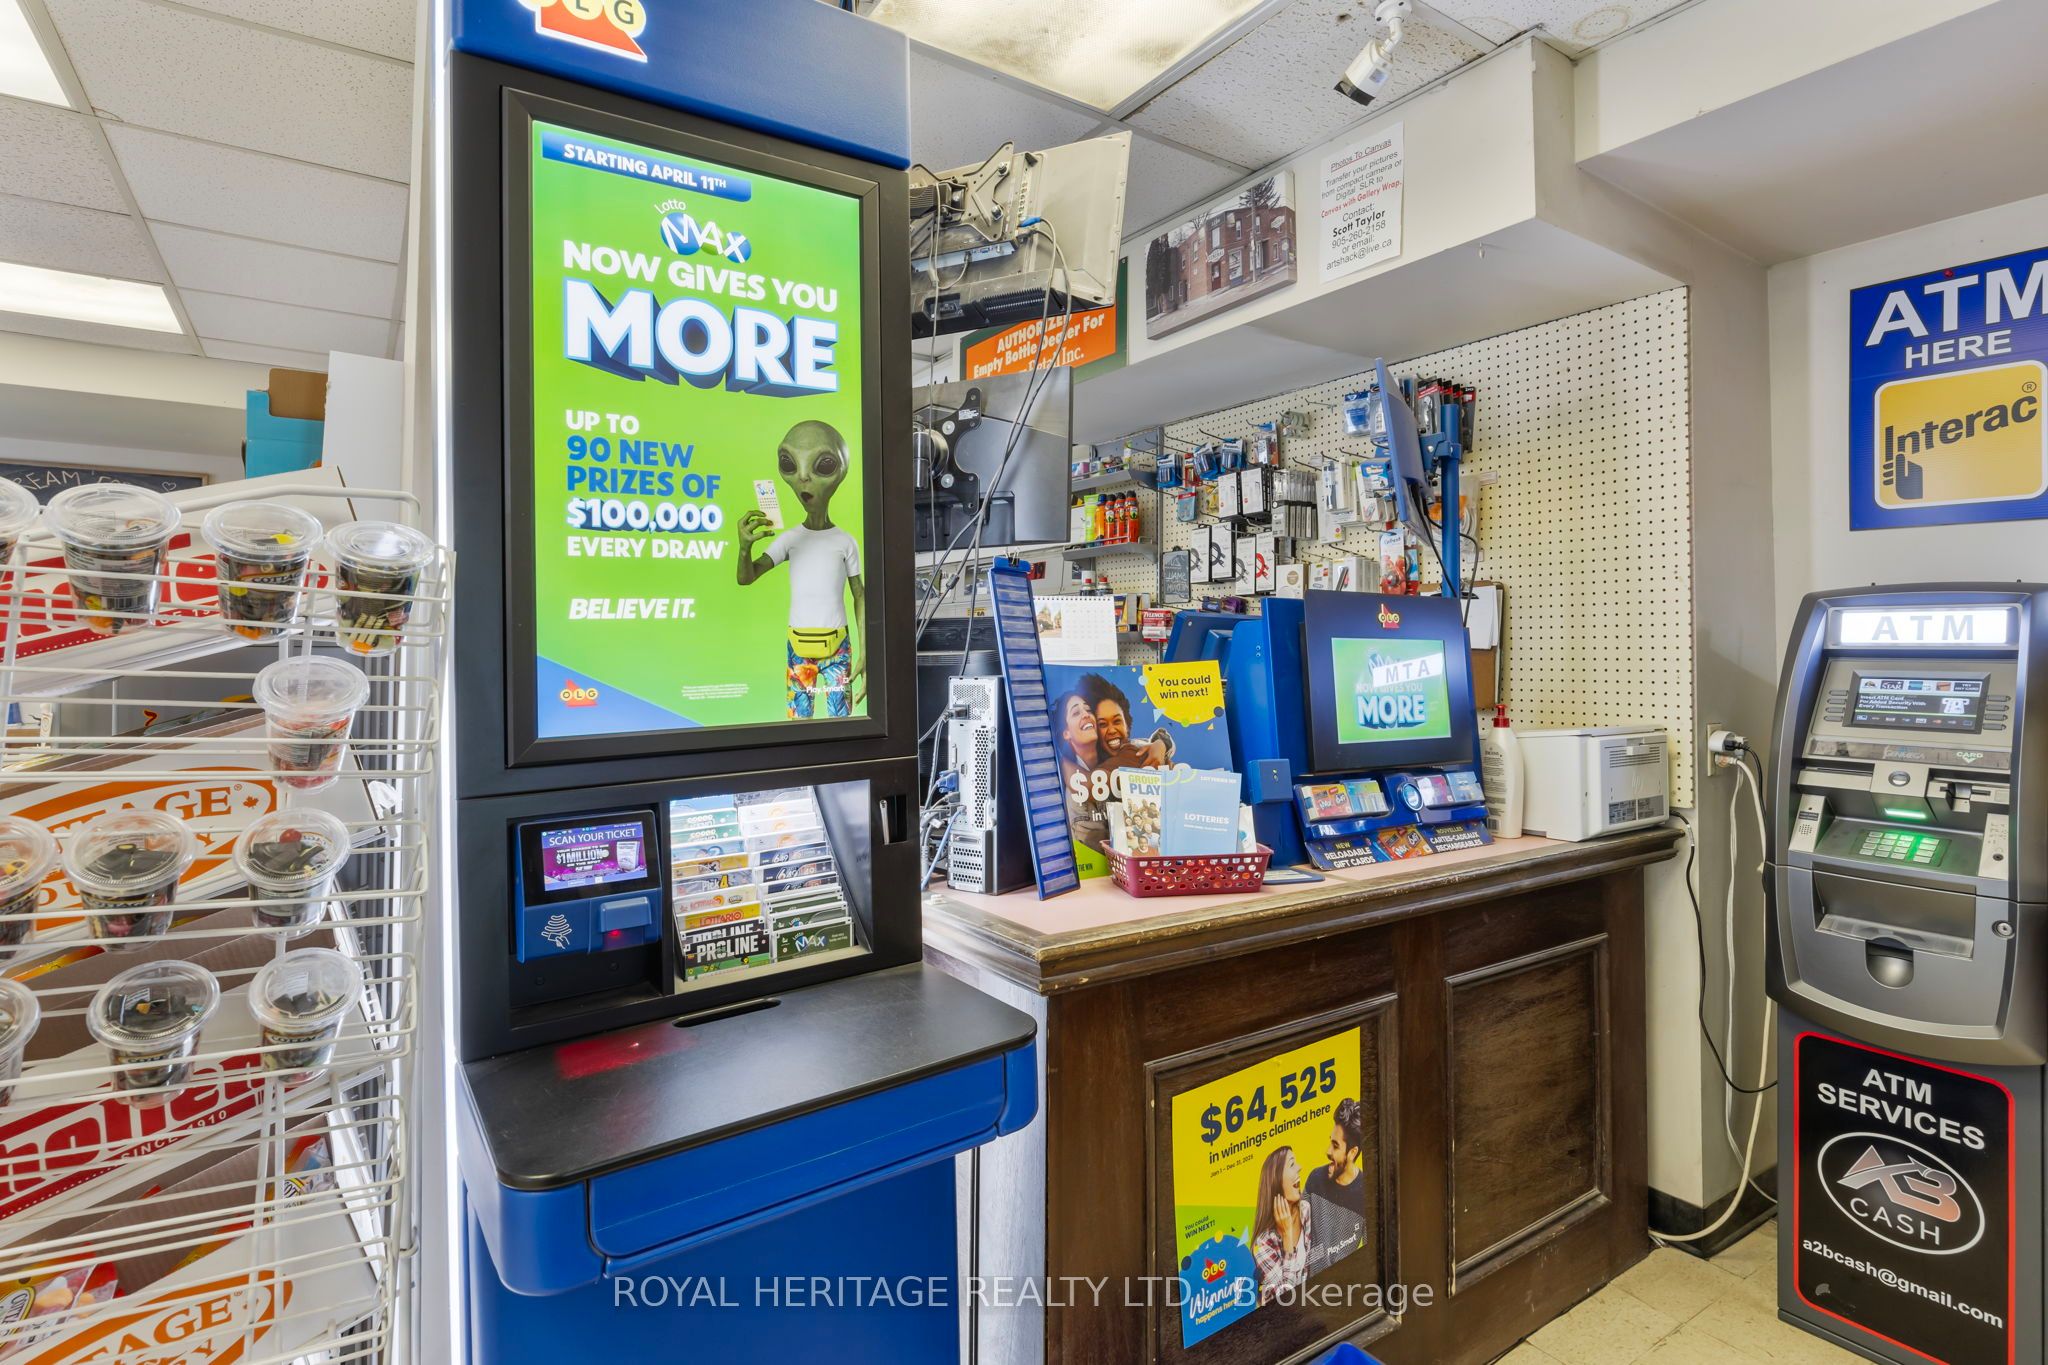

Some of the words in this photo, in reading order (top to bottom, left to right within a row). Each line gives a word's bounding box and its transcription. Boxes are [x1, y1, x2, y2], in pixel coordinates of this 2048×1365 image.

[1355, 150, 1363, 159] To
[1364, 139, 1392, 156] Canvas
[563, 143, 648, 177] STARTING
[651, 163, 697, 188] APRIL
[1322, 187, 1335, 200] from
[1337, 175, 1364, 194] compact
[1365, 165, 1393, 180] camera
[1395, 159, 1402, 168] or
[1325, 170, 1351, 187] Transfer
[1353, 163, 1368, 177] your
[1369, 152, 1398, 172] pictures
[1321, 204, 1342, 218] Canvas
[1342, 196, 1356, 209] with
[1357, 187, 1381, 204] Gallery
[1336, 187, 1355, 202] Digital
[1359, 178, 1375, 191] SLR
[1376, 176, 1384, 185] to
[653, 199, 686, 215] Lotto
[1342, 203, 1375, 223] Contact:
[661, 212, 752, 263] MAX
[1331, 219, 1387, 249] 905-260-2158
[1332, 223, 1354, 238] Scott
[1355, 209, 1386, 228] Taylor
[1326, 238, 1393, 271] artshack@live.ca
[1341, 244, 1350, 255] or
[1352, 235, 1375, 251] email:
[563, 239, 661, 283] NOW
[667, 262, 766, 301] GIVES
[772, 277, 838, 312] YOU
[1865, 260, 2048, 347] ATM
[563, 276, 839, 398] MORE
[973, 356, 1003, 379] Empty
[1005, 344, 1038, 366] Bottle
[1083, 312, 1105, 333] For
[1905, 330, 2012, 369] HERE
[566, 410, 601, 431] UP
[606, 412, 640, 436] TO
[1884, 395, 2037, 462] Interac
[567, 435, 611, 463] 90
[618, 438, 695, 469] NEW
[567, 465, 674, 497] PRIZES
[681, 473, 721, 499] OF
[566, 496, 724, 535] $100,000
[567, 535, 646, 558] EVERY
[568, 597, 669, 621] BELIEVE
[671, 598, 697, 620] IT.
[1871, 614, 1974, 641] ATM
[1158, 677, 1179, 688] You
[1181, 675, 1212, 687] could
[1385, 660, 1430, 684] MTA
[1159, 689, 1180, 700] win
[1181, 687, 1209, 699] next!
[1356, 694, 1427, 728] MORE
[1130, 784, 1161, 796] PLAY
[1184, 813, 1230, 825] LOTTERIES
[549, 836, 576, 847] SCAN
[577, 831, 604, 842] YOUR
[605, 828, 637, 840] TICKET
[1430, 831, 1480, 844] CARTES-CADEAUX
[1436, 839, 1484, 852] RECHARGEABLES
[1324, 847, 1372, 860] RELOADABLE
[1333, 858, 1351, 868] GIFT
[1351, 856, 1376, 866] CARDS
[696, 934, 759, 963] PROLINE
[1862, 1068, 1933, 1105] ATM
[1200, 1057, 1337, 1146] $64,525
[1817, 1082, 1986, 1151] SERVICES
[1208, 1151, 1220, 1165] in
[1221, 1130, 1267, 1159] winnings
[1269, 1113, 1309, 1141] claimed
[1309, 1102, 1331, 1125] here
[1184, 1222, 1195, 1231] You
[1195, 1215, 1209, 1227] could
[1184, 1229, 1198, 1240] WIN
[1849, 1197, 1941, 1246] CASH
[1203, 1261, 1226, 1279] OLG
[1802, 1239, 2003, 1329] a2bcash@gmail.com
[1189, 1276, 1246, 1319] Winning
